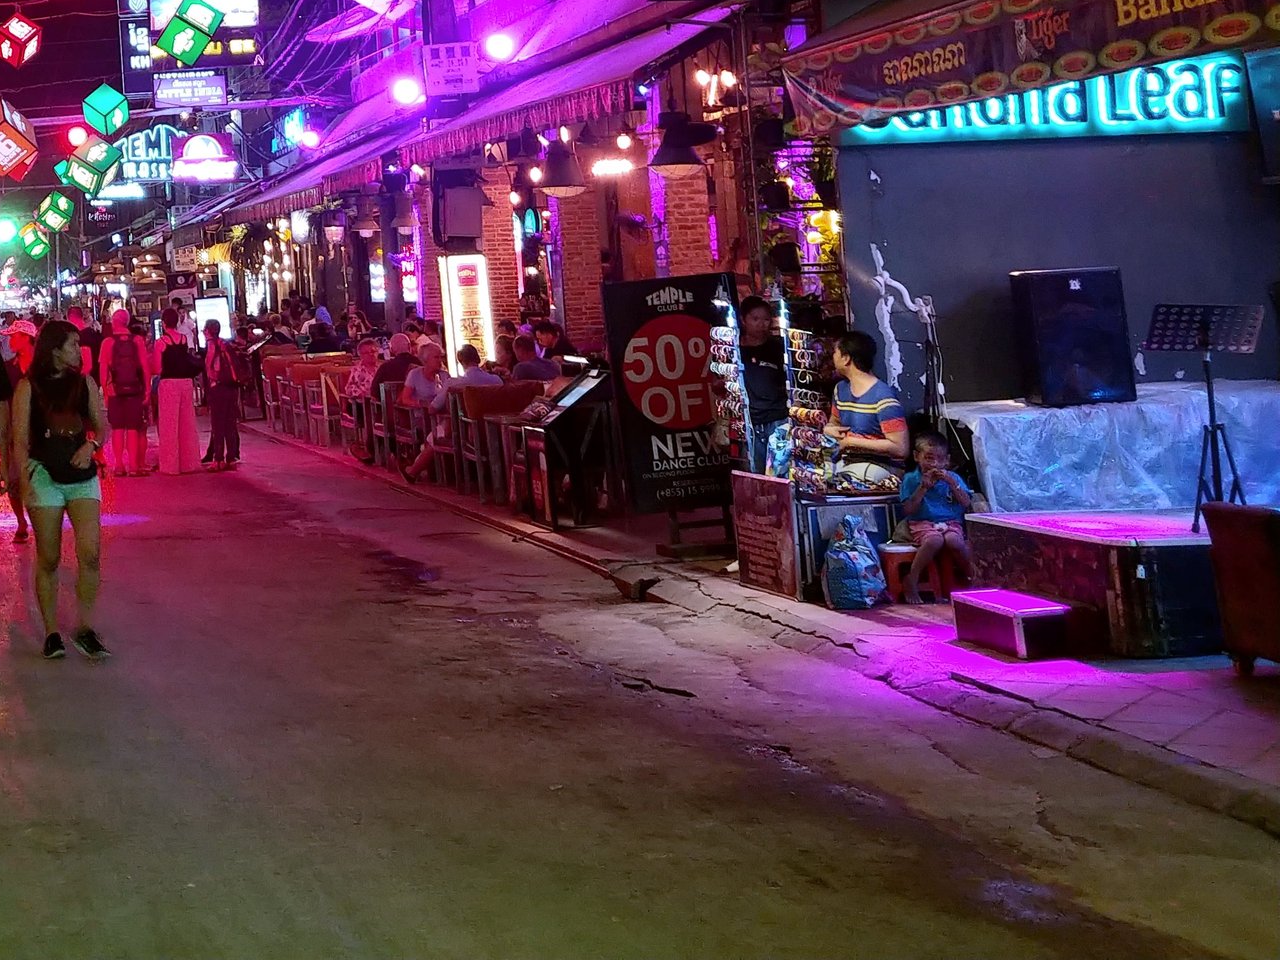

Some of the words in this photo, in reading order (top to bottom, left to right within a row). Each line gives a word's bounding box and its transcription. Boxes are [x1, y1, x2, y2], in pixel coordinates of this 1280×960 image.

[1029, 8, 1071, 50] Tiger
[858, 81, 1089, 129] nana
[1102, 62, 1242, 125] Leaf
[645, 286, 694, 307] TEMPLE
[657, 304, 677, 313] CLUB
[641, 382, 717, 425] OF
[650, 430, 722, 460] NEW
[652, 456, 695, 471] DANCE
[697, 453, 730, 467] CLUB
